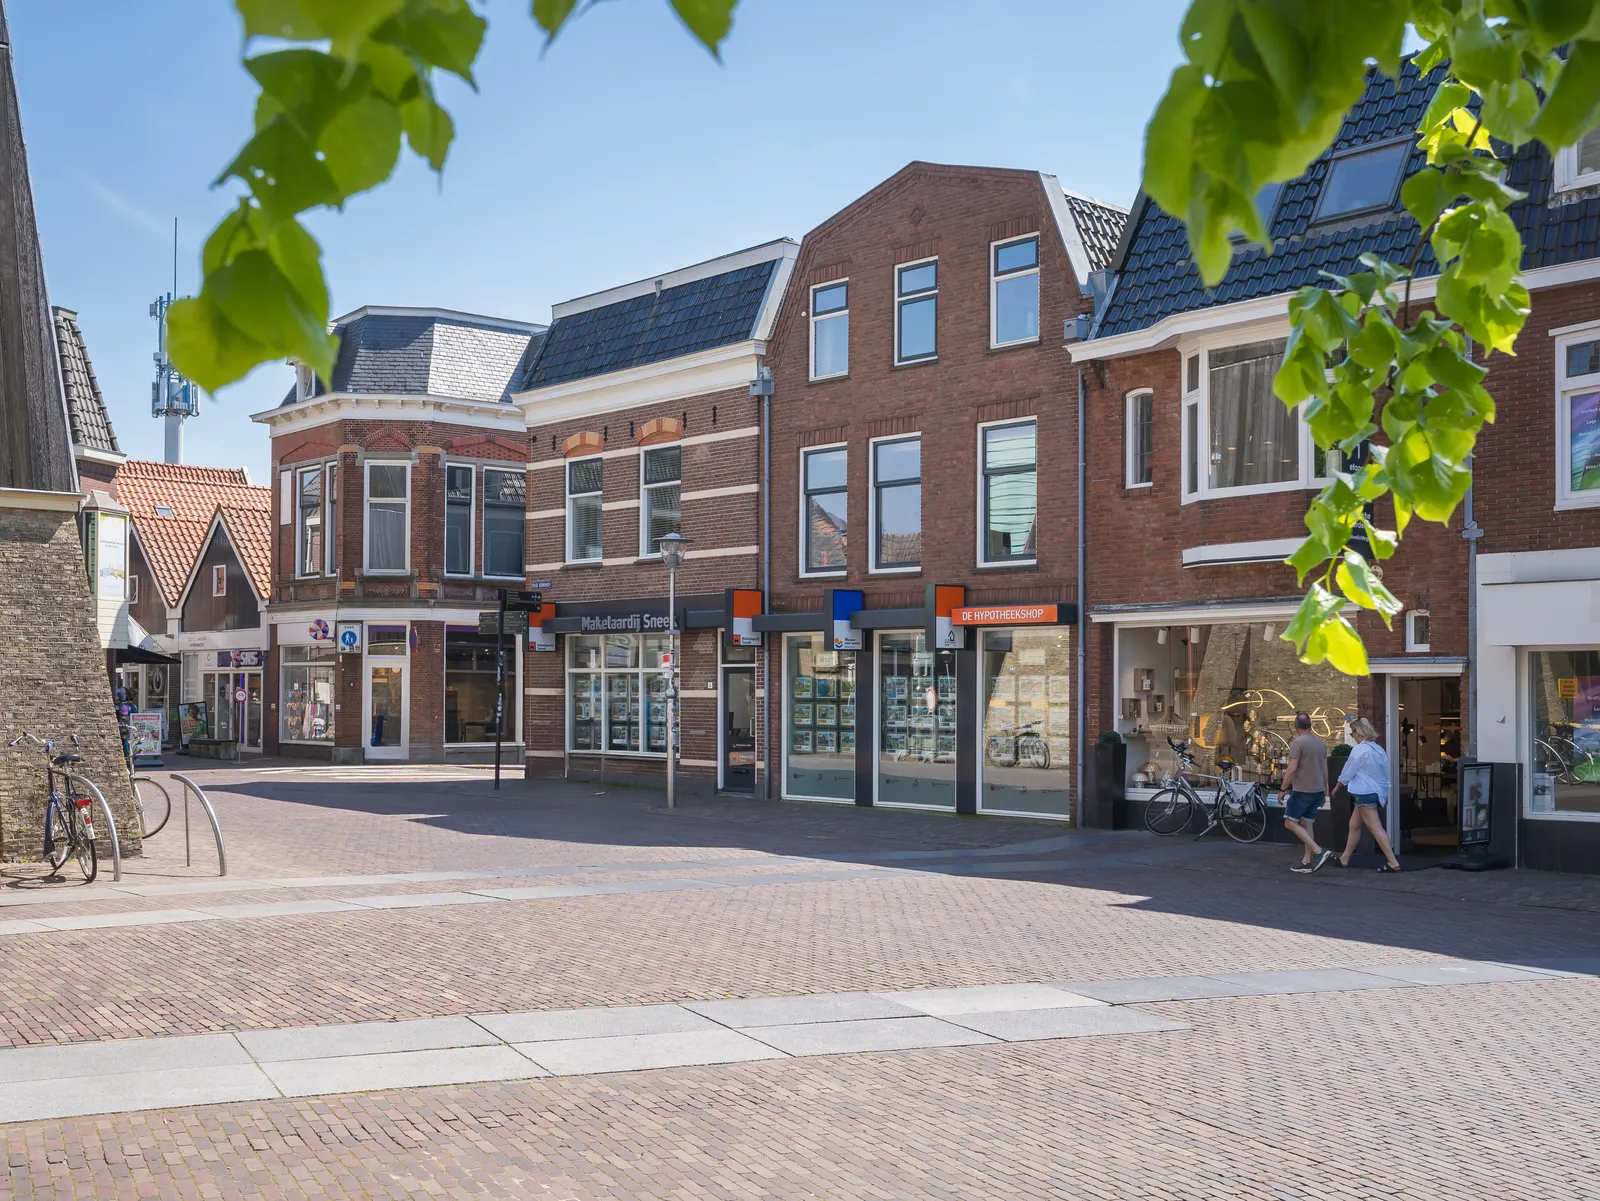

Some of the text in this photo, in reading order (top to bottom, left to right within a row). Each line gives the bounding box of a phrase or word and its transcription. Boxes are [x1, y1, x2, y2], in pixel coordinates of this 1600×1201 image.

[962, 608, 1044, 621] DE HYPOTHEEKSHOP
[581, 614, 641, 632] Makelaardij
[240, 651, 258, 666] SNS
